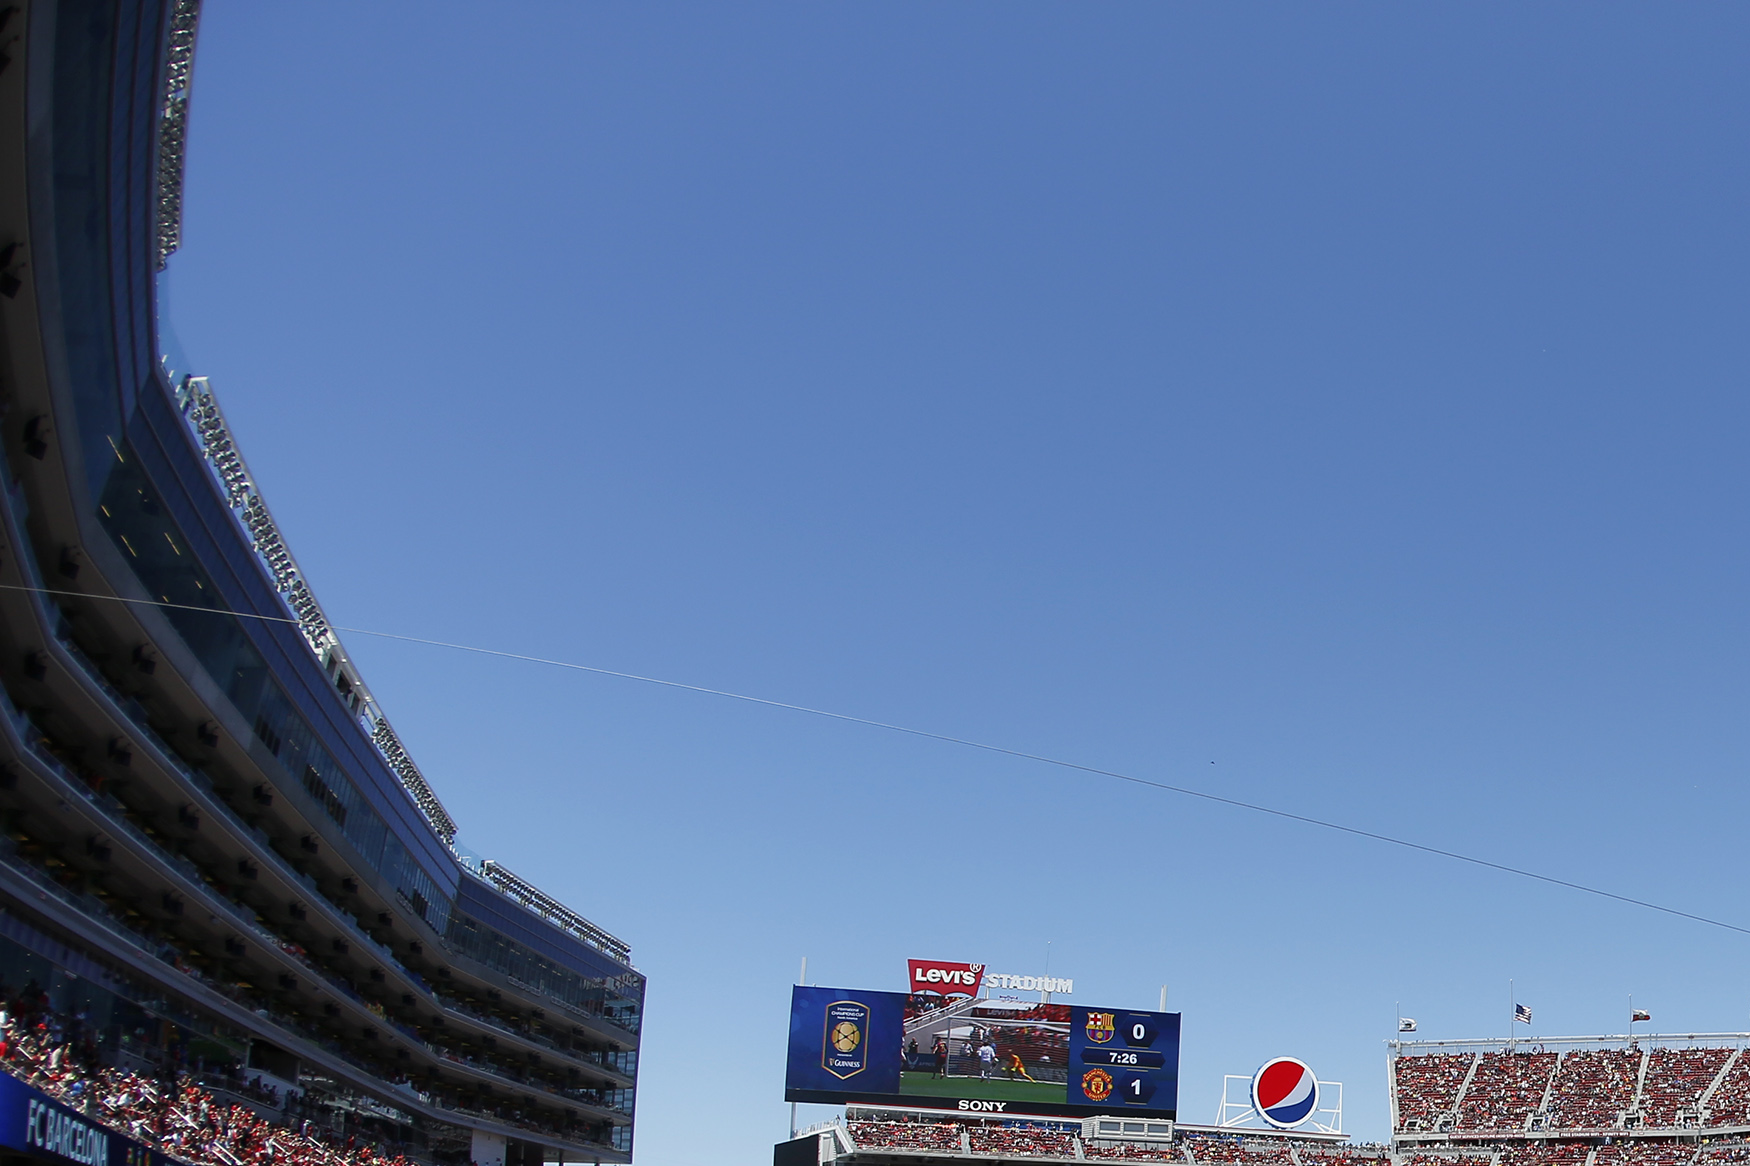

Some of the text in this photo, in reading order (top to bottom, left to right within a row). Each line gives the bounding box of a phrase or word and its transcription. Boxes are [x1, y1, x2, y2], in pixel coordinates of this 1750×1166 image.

[986, 973, 1073, 994] STADIUM
[1133, 1024, 1145, 1039] 0
[834, 1059, 860, 1068] GUINNESS
[1109, 1052, 1138, 1064] 7:26
[1131, 1079, 1140, 1095] 1
[958, 1099, 1007, 1112] SONY
[27, 1098, 45, 1147] FC
